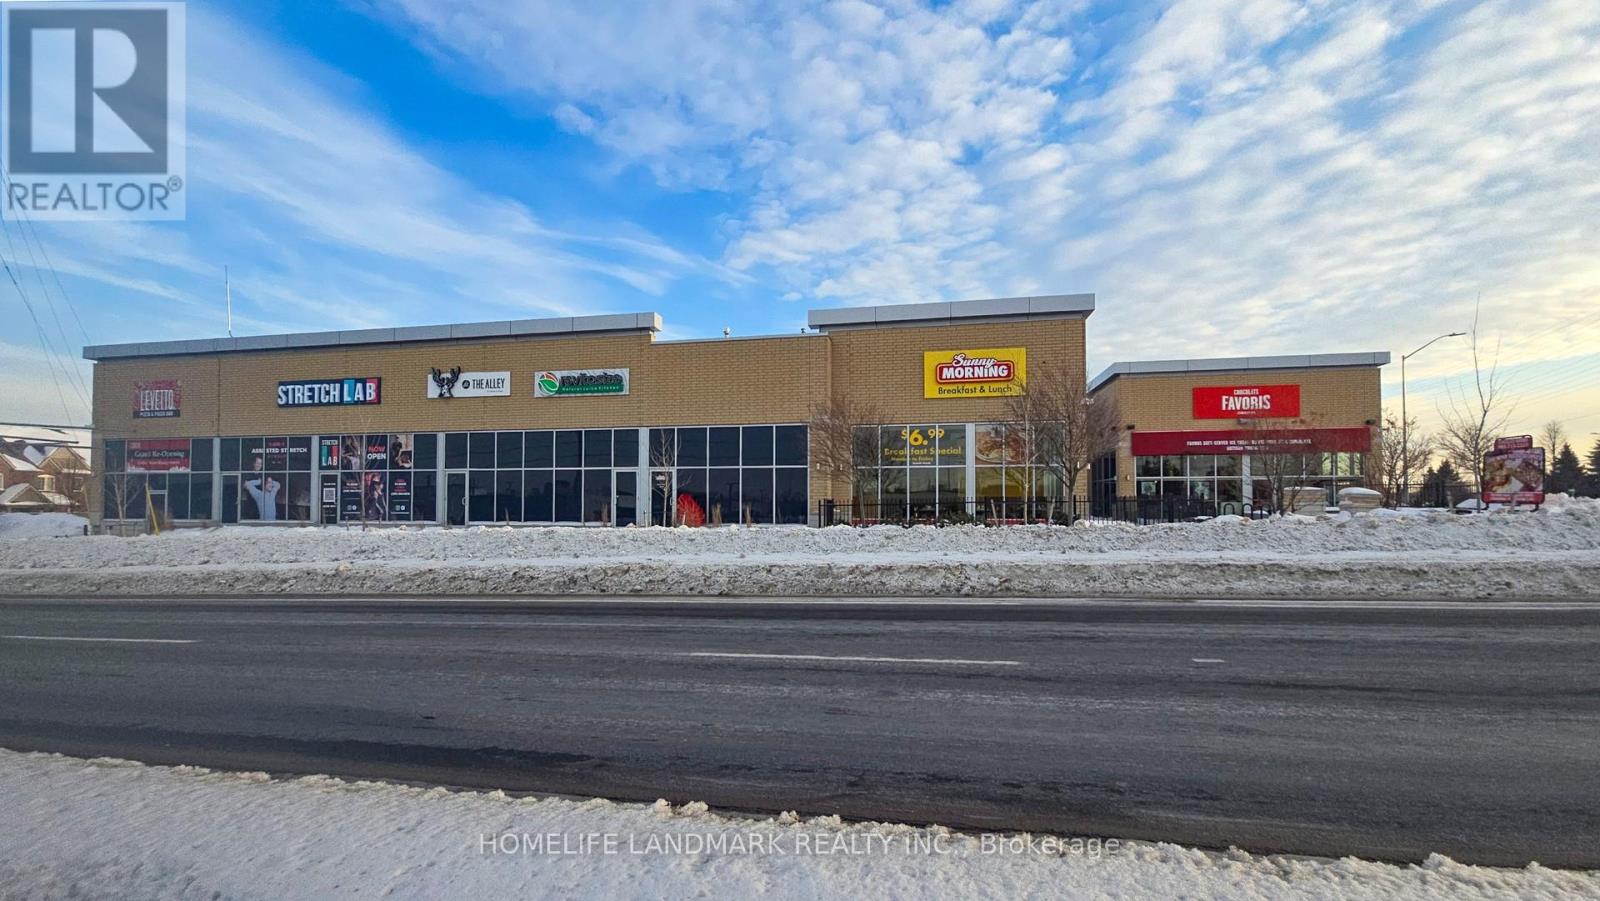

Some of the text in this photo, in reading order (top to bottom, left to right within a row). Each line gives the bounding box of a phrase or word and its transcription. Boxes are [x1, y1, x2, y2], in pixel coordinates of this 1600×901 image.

[953, 353, 997, 368] Sunny
[472, 377, 505, 389] THE ALLEY
[938, 386, 977, 395] Breakfast
[988, 385, 1012, 393] Lunch
[140, 390, 175, 410] LEVETTO
[277, 383, 377, 404] STRETCH LAB
[1221, 395, 1271, 411] FAVORIS
[321, 456, 338, 466] LAB
